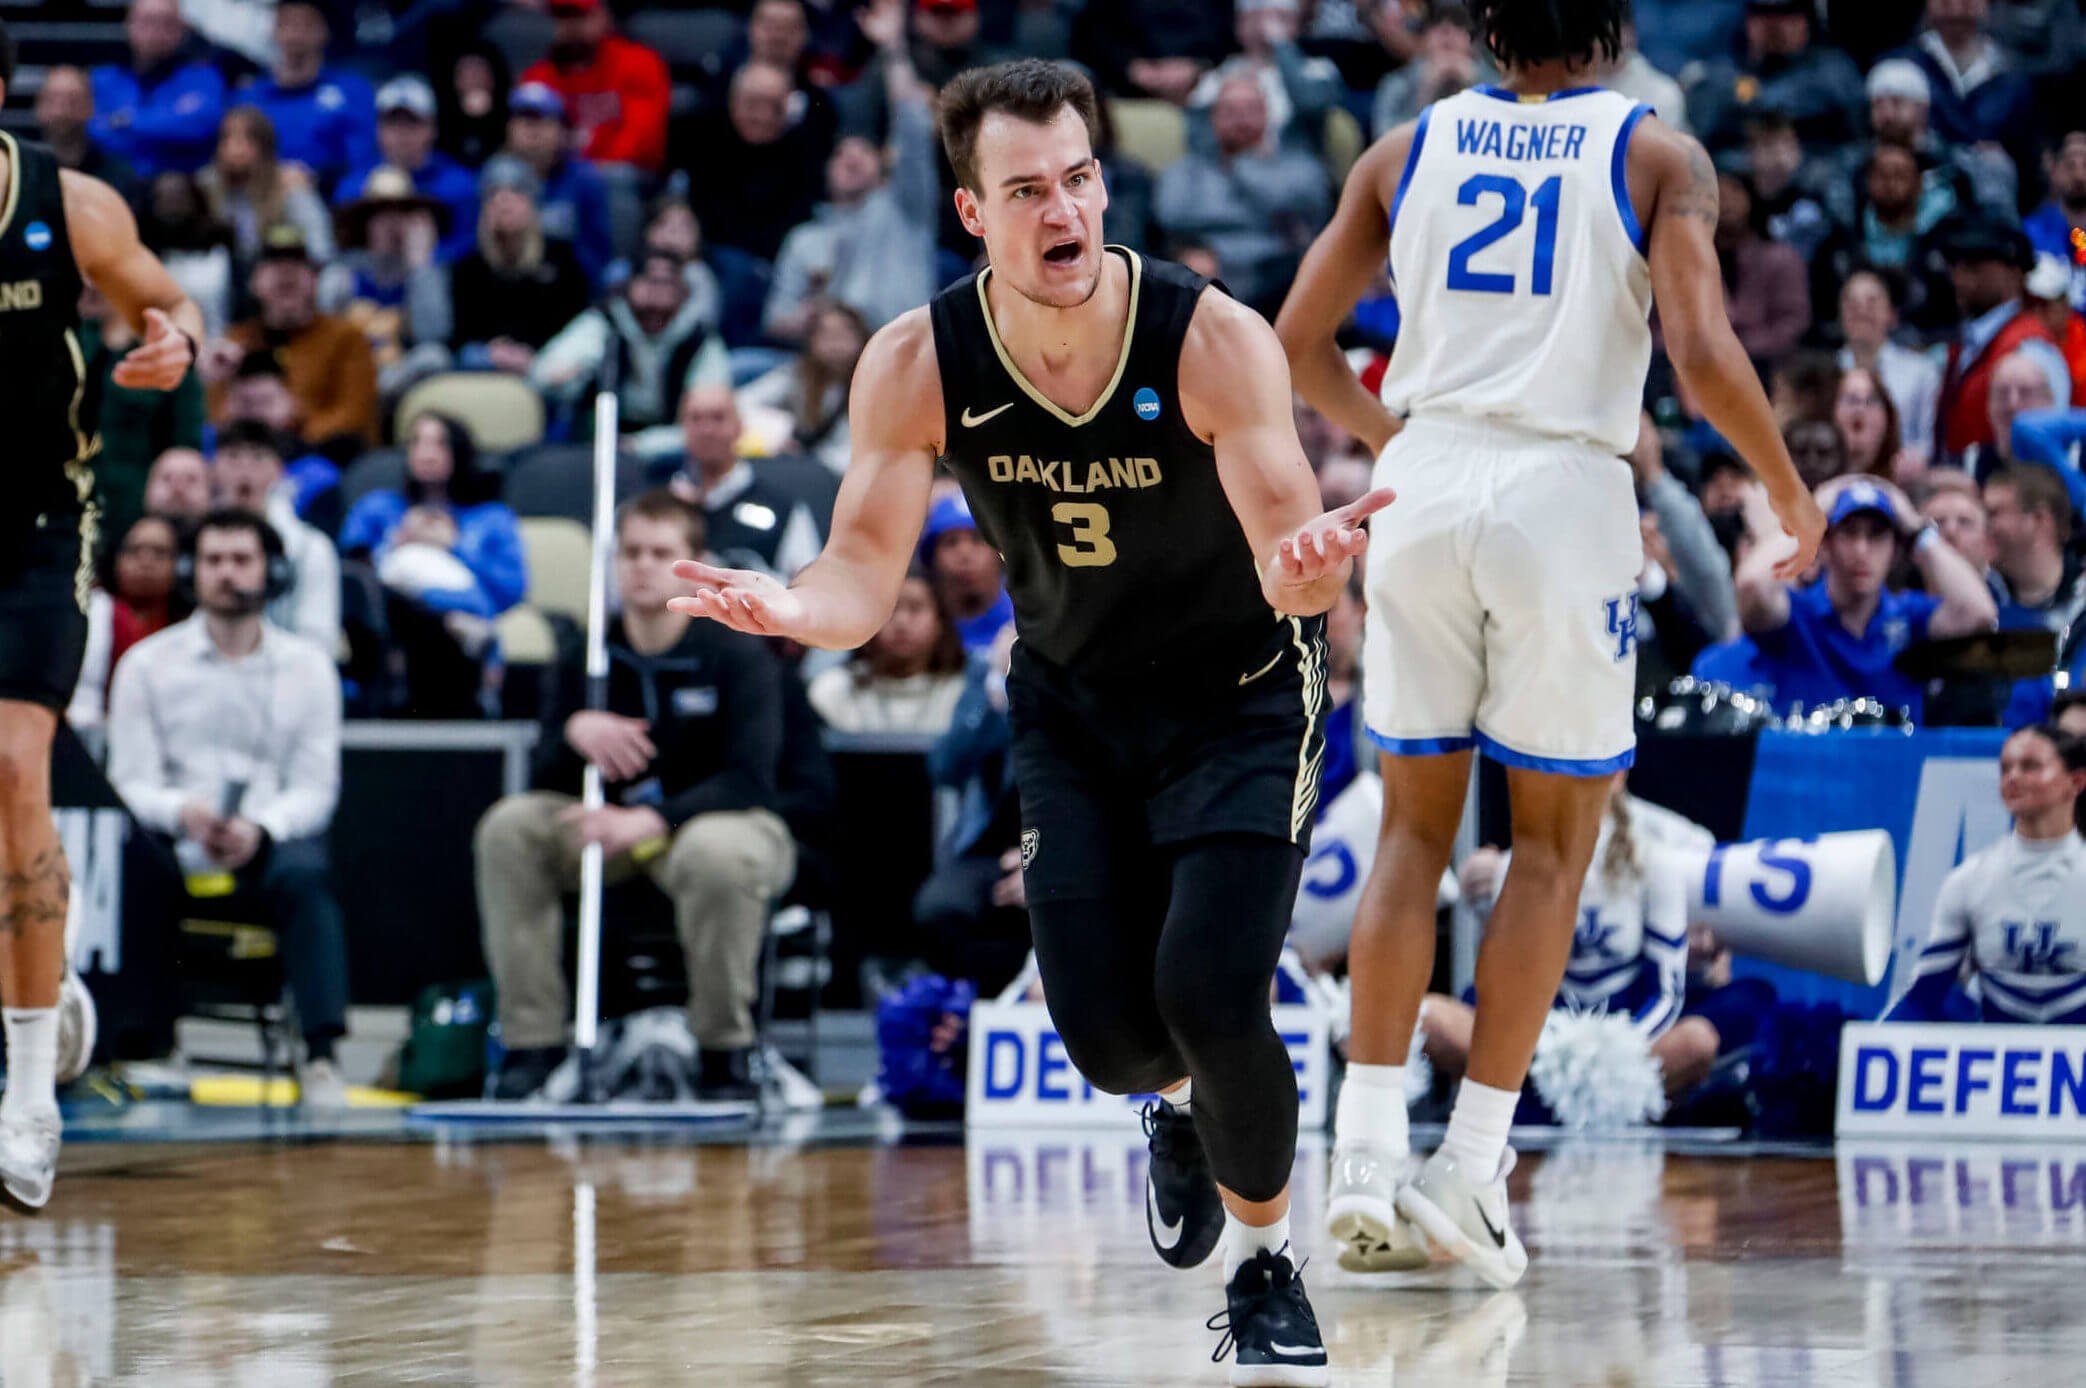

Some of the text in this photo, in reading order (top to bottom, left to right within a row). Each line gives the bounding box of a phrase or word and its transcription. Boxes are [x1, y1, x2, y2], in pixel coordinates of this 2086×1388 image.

[1456, 118, 1587, 161] WAGNER
[1447, 173, 1562, 296] 21
[987, 455, 1162, 493] OAKLAND
[1051, 502, 1117, 568] 3
[2002, 920, 2078, 975] UK
[1852, 1047, 2086, 1116] DEFEN
